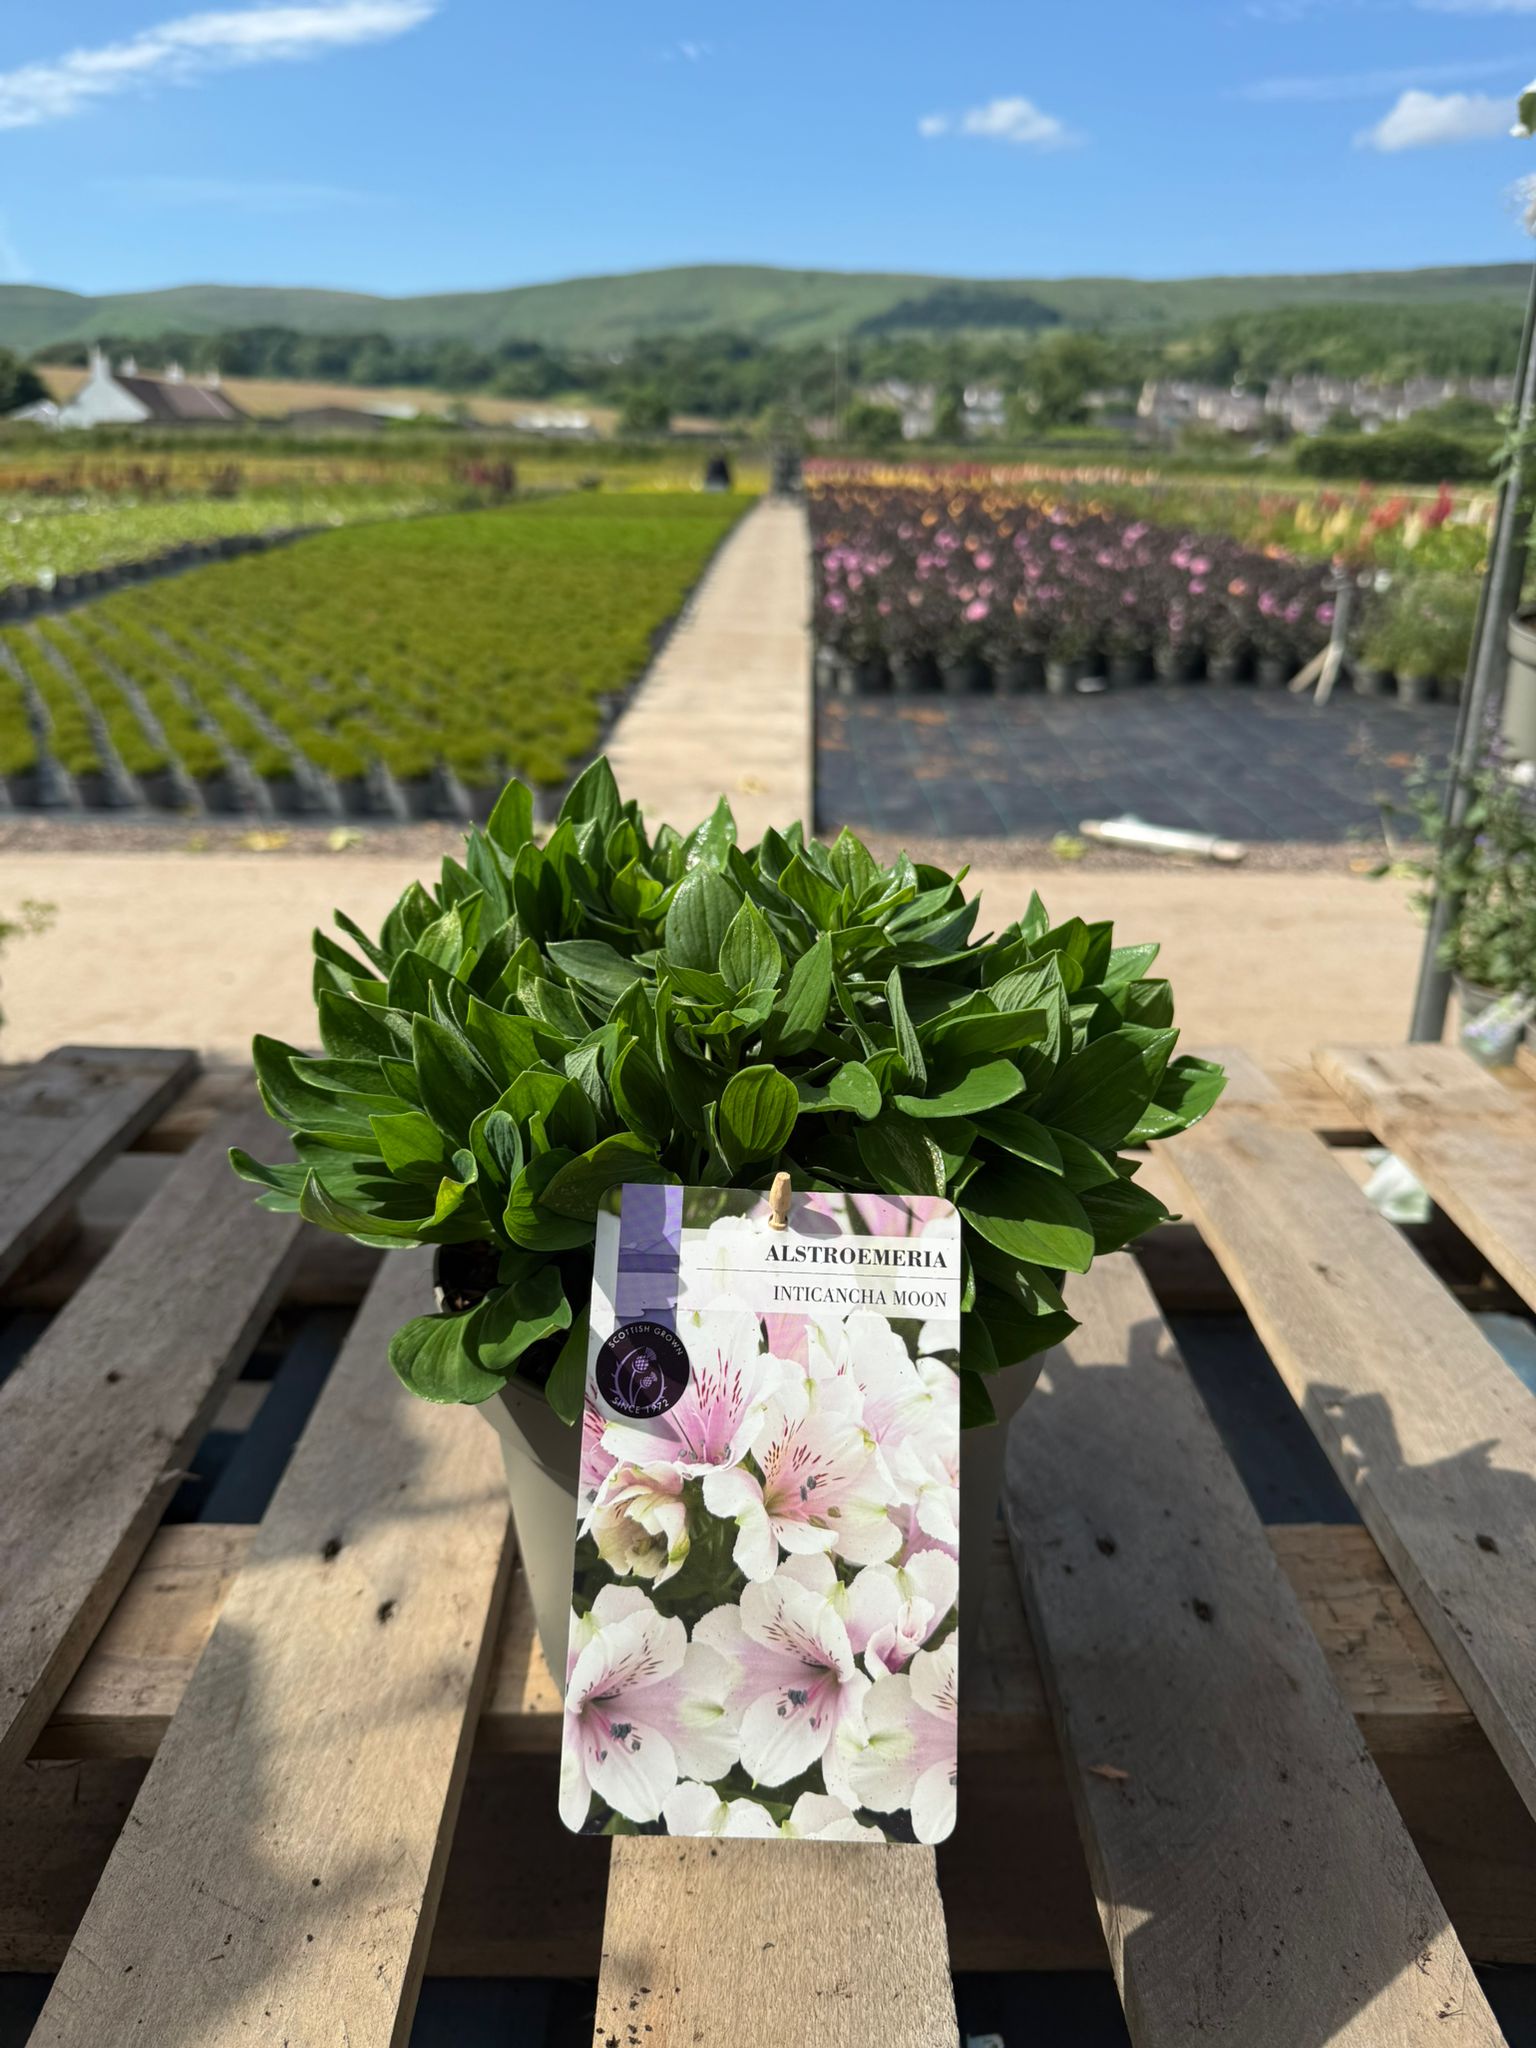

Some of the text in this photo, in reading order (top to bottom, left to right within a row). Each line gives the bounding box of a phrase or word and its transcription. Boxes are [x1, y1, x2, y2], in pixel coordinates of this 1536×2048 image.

[765, 1244, 947, 1268] ALSTROEMERIA
[773, 1285, 947, 1308] INTICANCHA MOON
[608, 1326, 683, 1355] SCOTTISH GROWN
[612, 1396, 669, 1414] SINCE 1972
